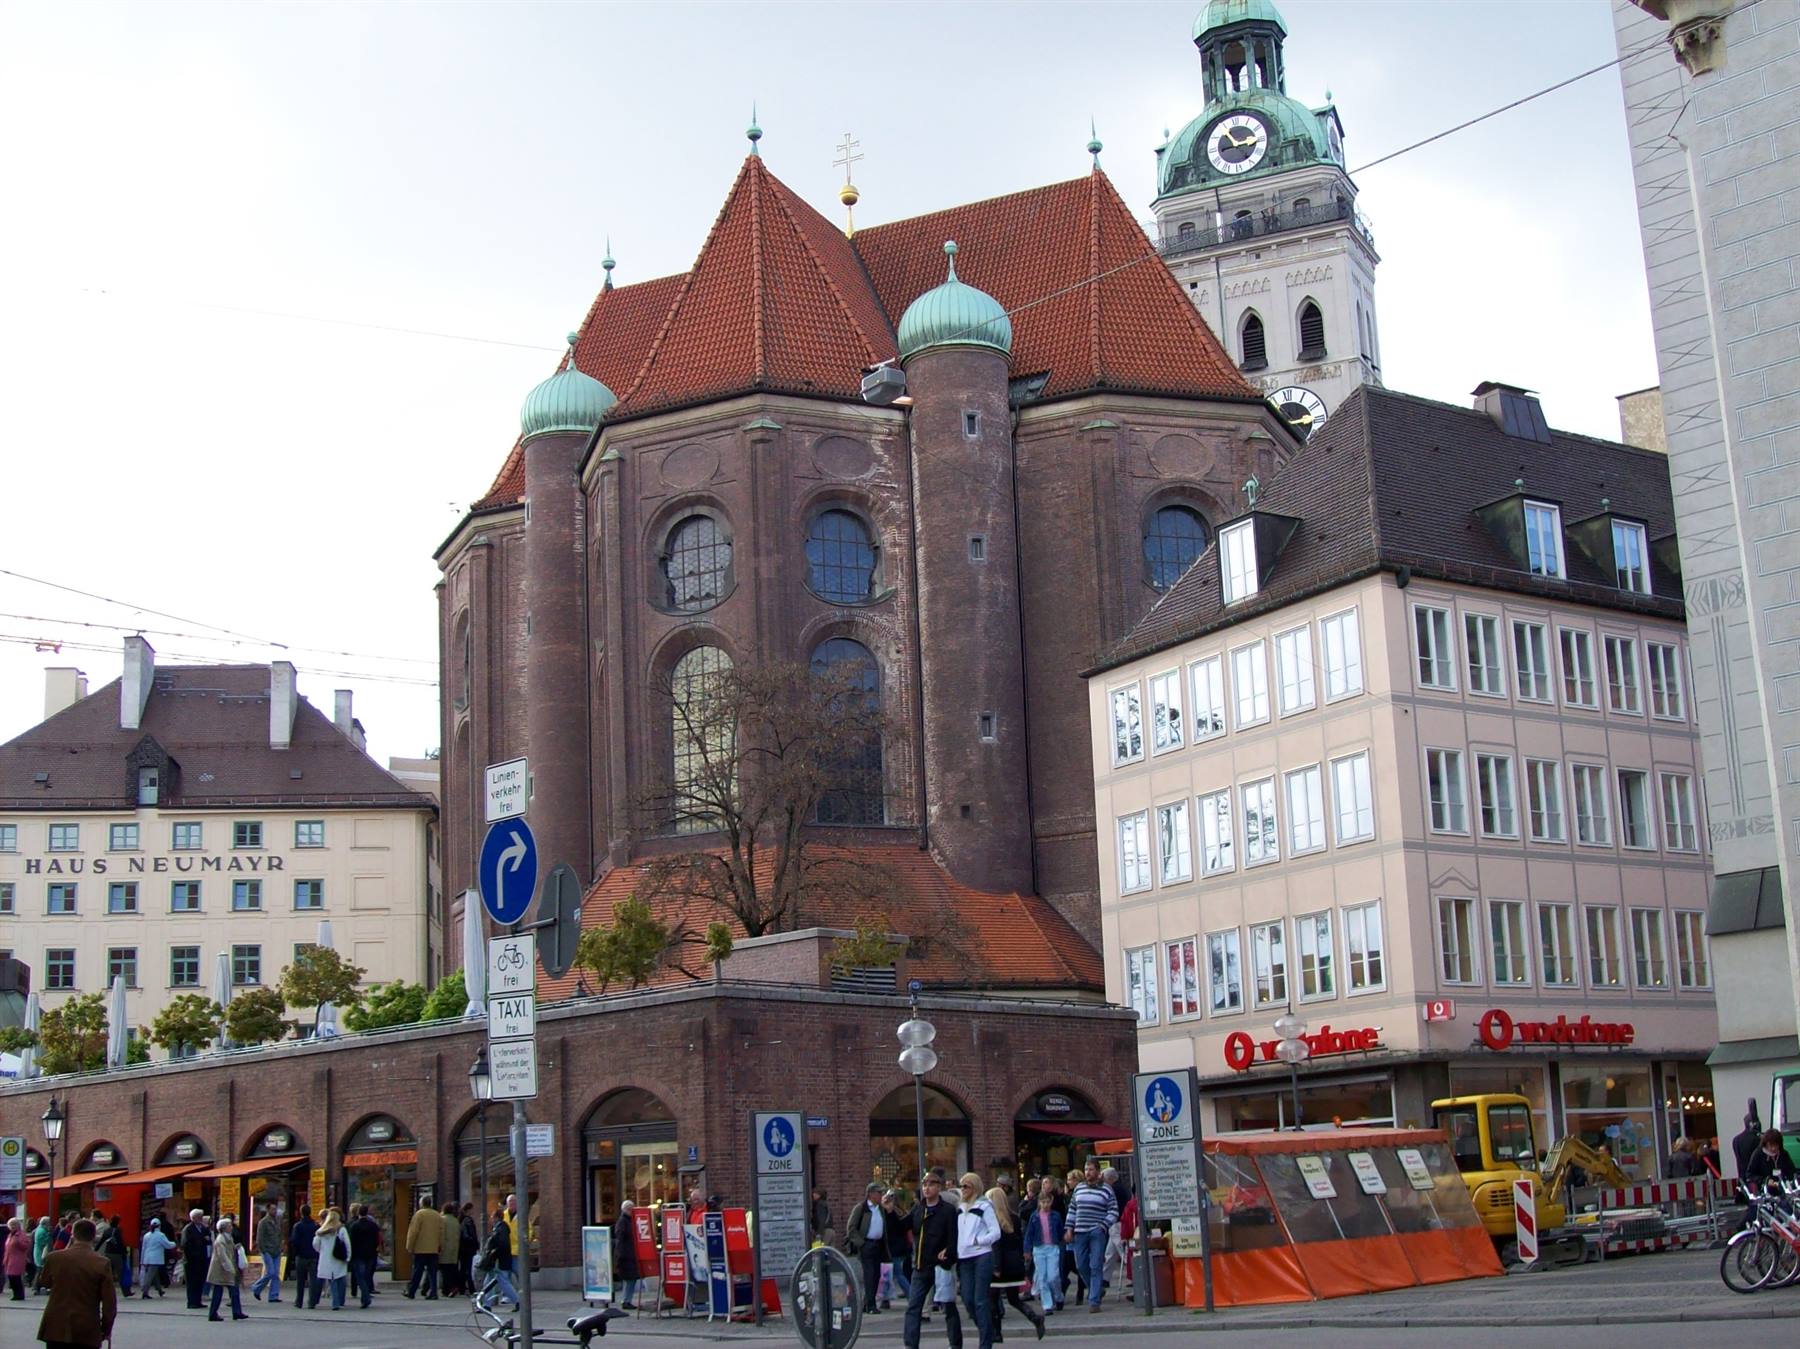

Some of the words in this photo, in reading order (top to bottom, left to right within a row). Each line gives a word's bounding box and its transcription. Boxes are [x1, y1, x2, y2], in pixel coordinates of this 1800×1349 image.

[490, 783, 522, 800] verkehr
[499, 799, 513, 813] frei
[25, 858, 107, 874] HAUS
[128, 856, 285, 873] NEUMAYR
[503, 975, 519, 987] frei
[497, 999, 526, 1019] TAXI
[505, 1023, 519, 1034] frei
[1518, 1014, 1636, 1044] vodafone
[1152, 1125, 1180, 1139] ZONE
[768, 1159, 792, 1171] ZONE
